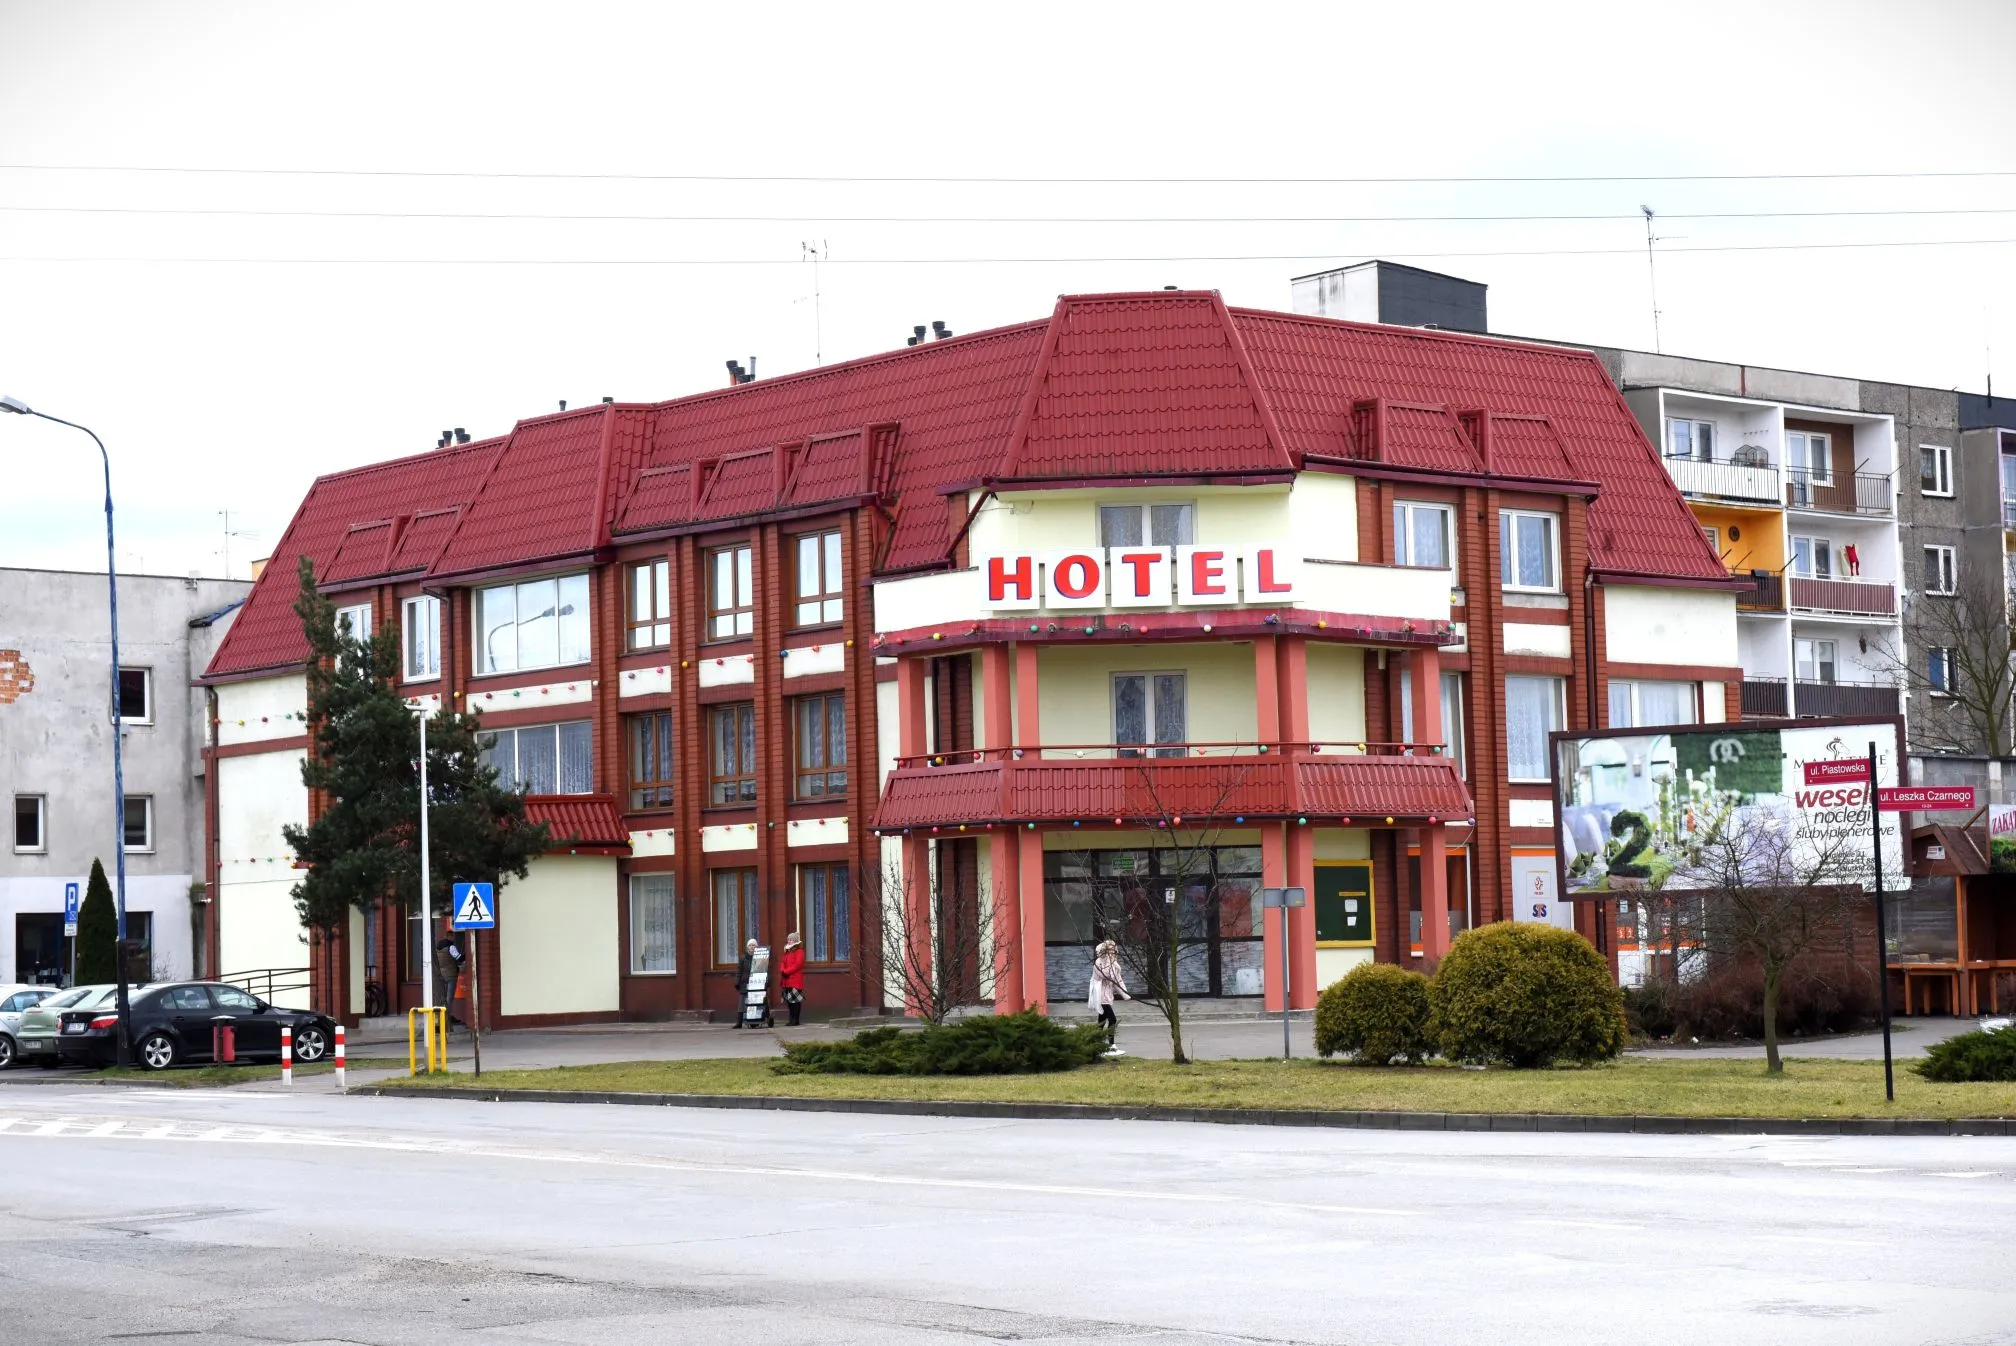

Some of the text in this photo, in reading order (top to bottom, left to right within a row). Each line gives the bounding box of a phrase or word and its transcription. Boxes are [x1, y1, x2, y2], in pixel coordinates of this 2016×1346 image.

[989, 549, 1292, 600] HOTEL
[1810, 763, 1866, 776] ul. Piastowska
[1880, 791, 1971, 802] ul. Leszka Czarnego
[1814, 806, 1872, 826] noclegi
[68, 886, 76, 911] P
